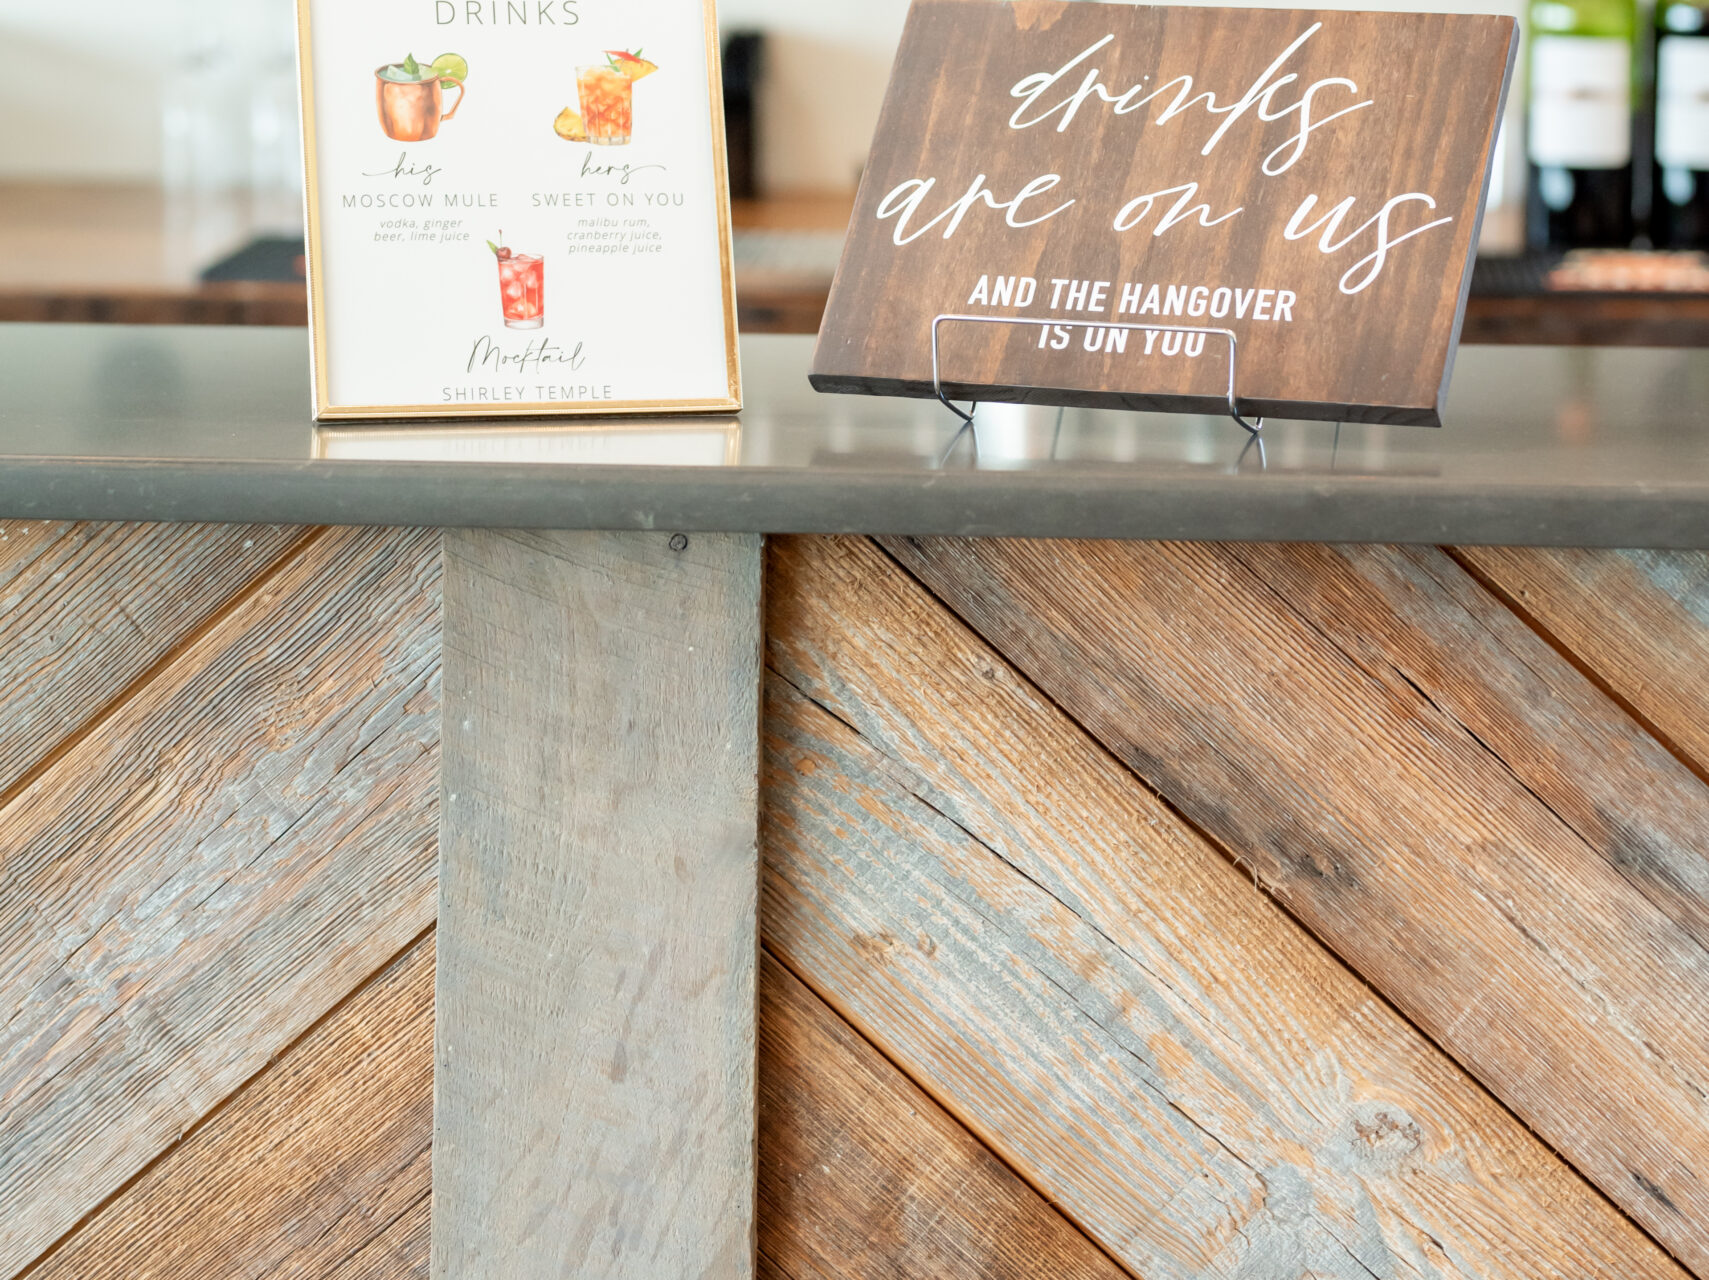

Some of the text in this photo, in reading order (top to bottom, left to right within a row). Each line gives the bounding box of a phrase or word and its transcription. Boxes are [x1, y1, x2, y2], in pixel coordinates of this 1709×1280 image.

[435, 0, 579, 26] DRINKS
[1008, 22, 1373, 176] drinks
[362, 151, 442, 186] his
[580, 151, 667, 185] hers
[342, 193, 499, 208] MOSCOW MULE
[532, 192, 685, 207] SWEET ON YOU
[379, 219, 463, 231] vodka, ginger
[577, 218, 651, 229] malibu rum,
[876, 173, 1453, 295] are on us
[374, 231, 471, 244] beer, lime juice
[566, 230, 662, 243] cranberry juice,
[567, 243, 663, 256] pineapple juice
[967, 274, 1297, 322] AND THE HANGOVER
[1038, 319, 1073, 350] IS
[467, 335, 586, 375] Mocktail
[442, 384, 613, 402] SHIRLEY TEMPLE
